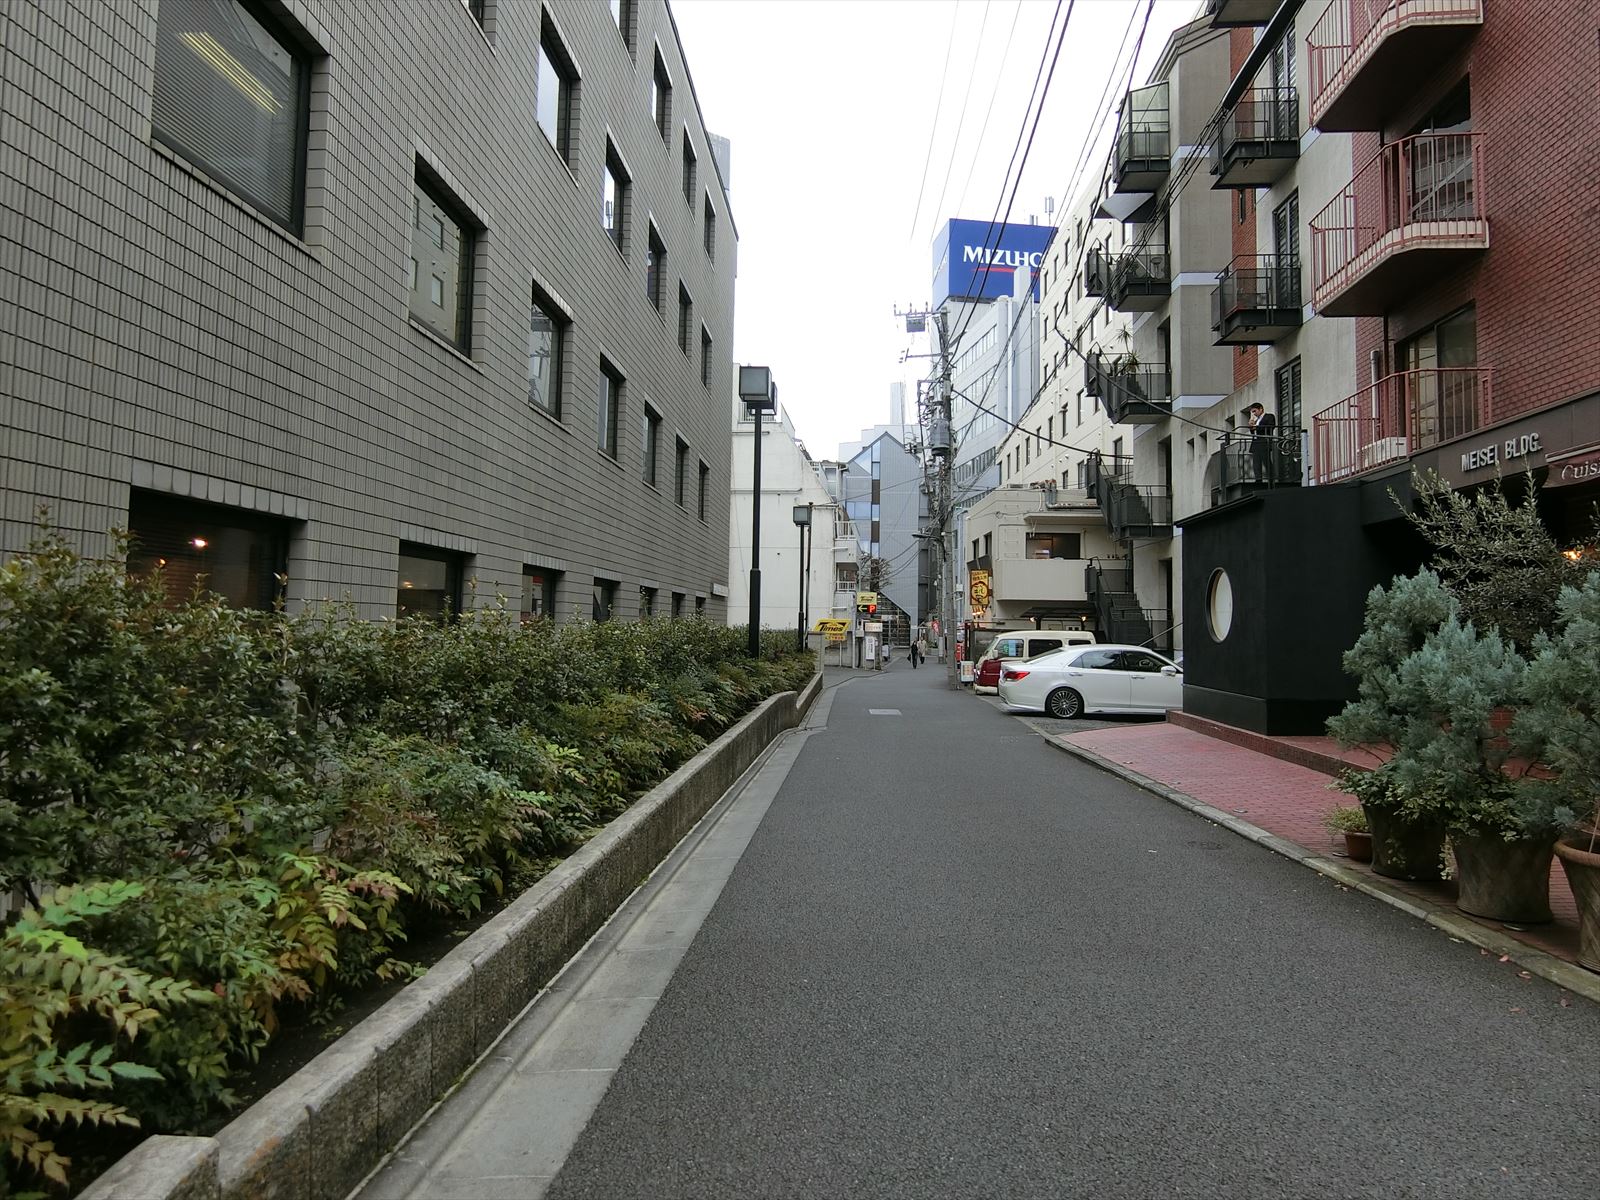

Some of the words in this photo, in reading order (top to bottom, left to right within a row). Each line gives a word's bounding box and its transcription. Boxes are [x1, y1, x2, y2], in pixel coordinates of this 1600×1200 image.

[1461, 444, 1499, 472] MEISEI
[1504, 432, 1543, 459] BLDG.
[1561, 461, 1600, 480] Cuis
[869, 605, 876, 613] P
[818, 621, 847, 632] Times
